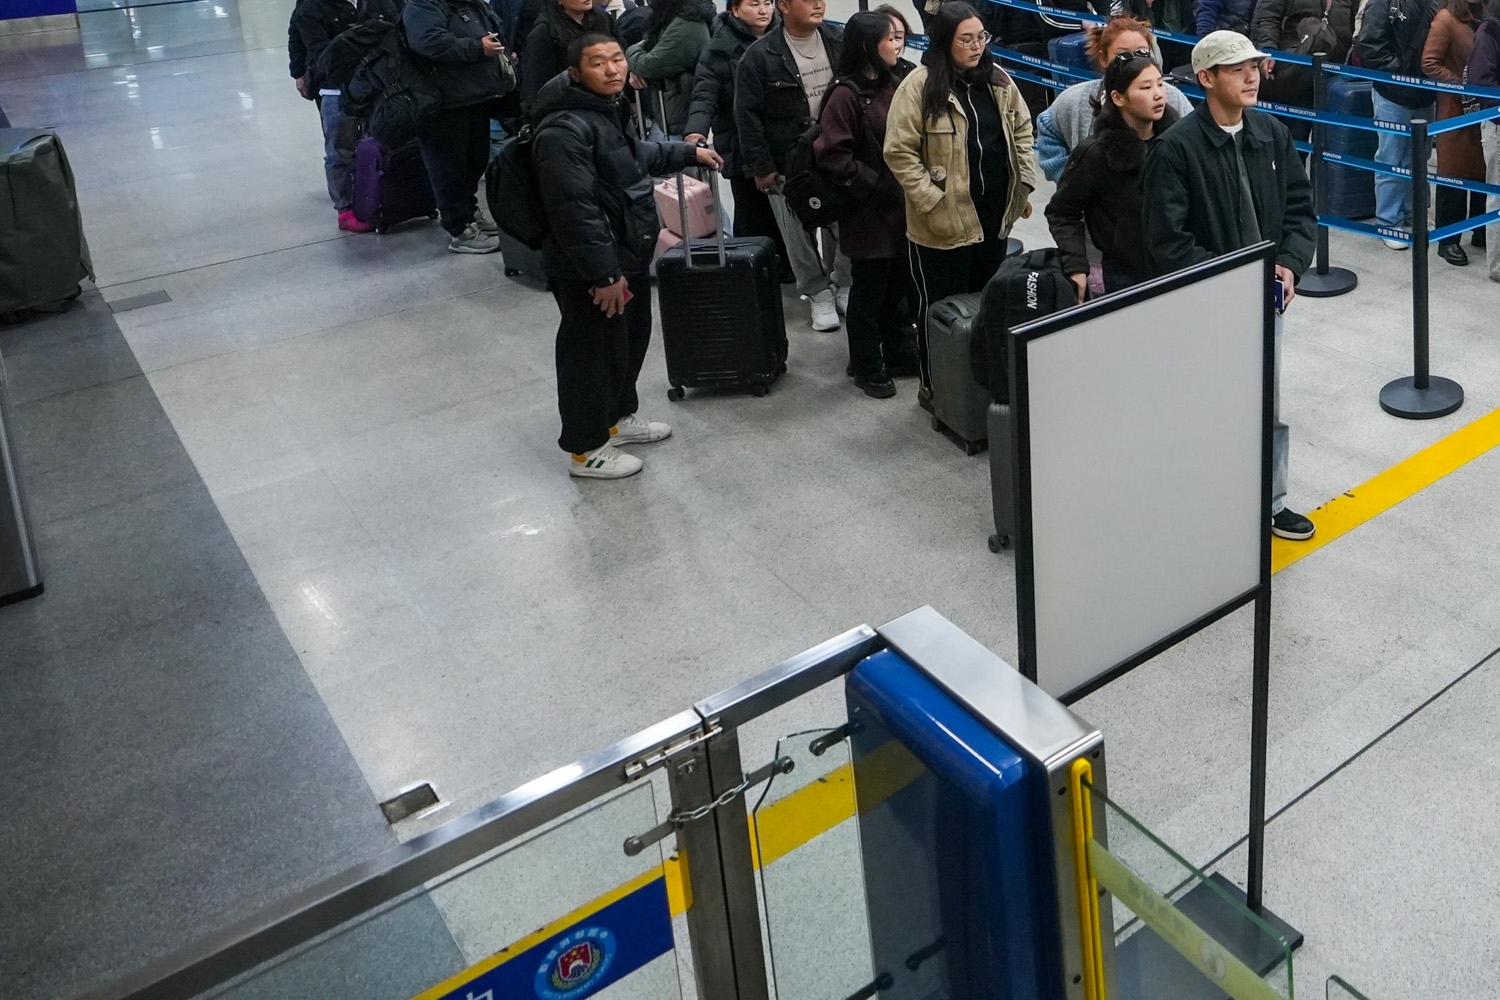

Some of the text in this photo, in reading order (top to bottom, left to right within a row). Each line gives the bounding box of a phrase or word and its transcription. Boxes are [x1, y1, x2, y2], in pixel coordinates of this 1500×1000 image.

[1436, 81, 1465, 90] IMMIGRATION
[1274, 104, 1288, 112] CHINA
[1289, 107, 1317, 117] IMMIGRATION
[1373, 119, 1406, 132] 中国移民管理
[1436, 175, 1464, 185] IMMIGRATION
[1026, 271, 1040, 310] FASHION
